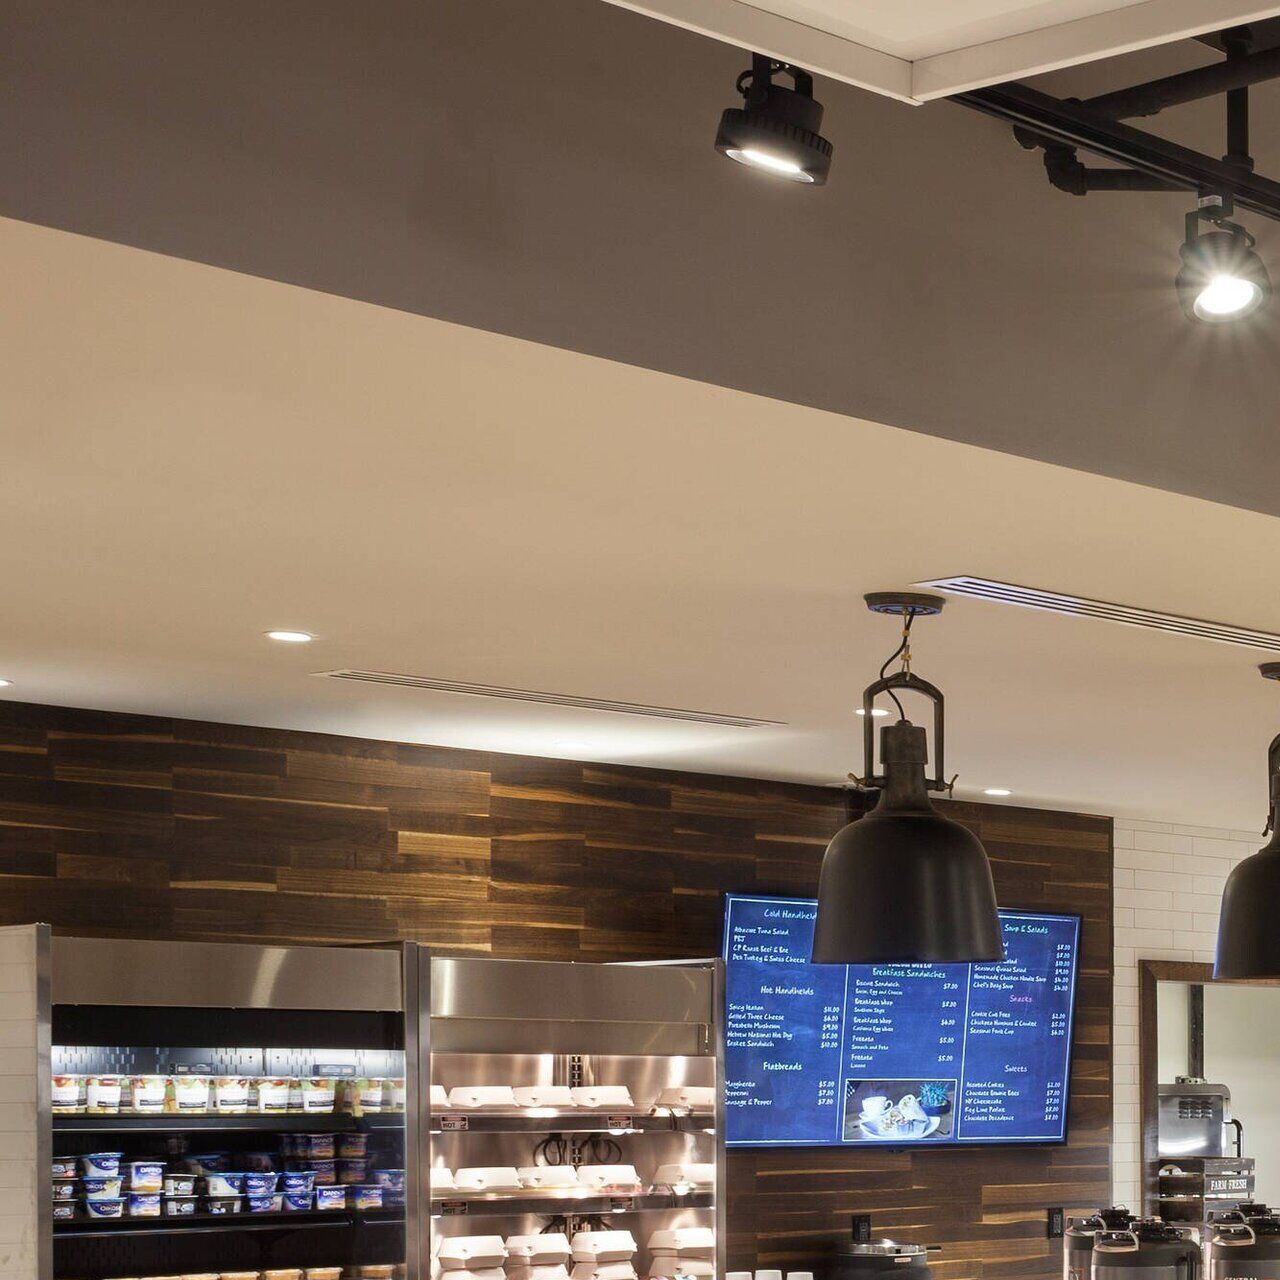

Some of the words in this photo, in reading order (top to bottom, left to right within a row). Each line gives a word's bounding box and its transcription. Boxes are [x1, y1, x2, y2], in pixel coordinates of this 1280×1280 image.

[764, 909, 779, 918] Cold
[1004, 924, 1019, 932] Soup
[1027, 926, 1048, 934] Salads
[872, 968, 905, 977] Breakfast
[906, 969, 946, 978] Sandwiches
[761, 986, 774, 994] Hot
[775, 987, 814, 995] Handhelds
[1009, 994, 1032, 1002] Snacks
[763, 1062, 802, 1070] Flatbreads
[1004, 1064, 1027, 1072] Sweets
[1210, 1179, 1227, 1190] FARM
[1228, 1178, 1247, 1189] FRESH
